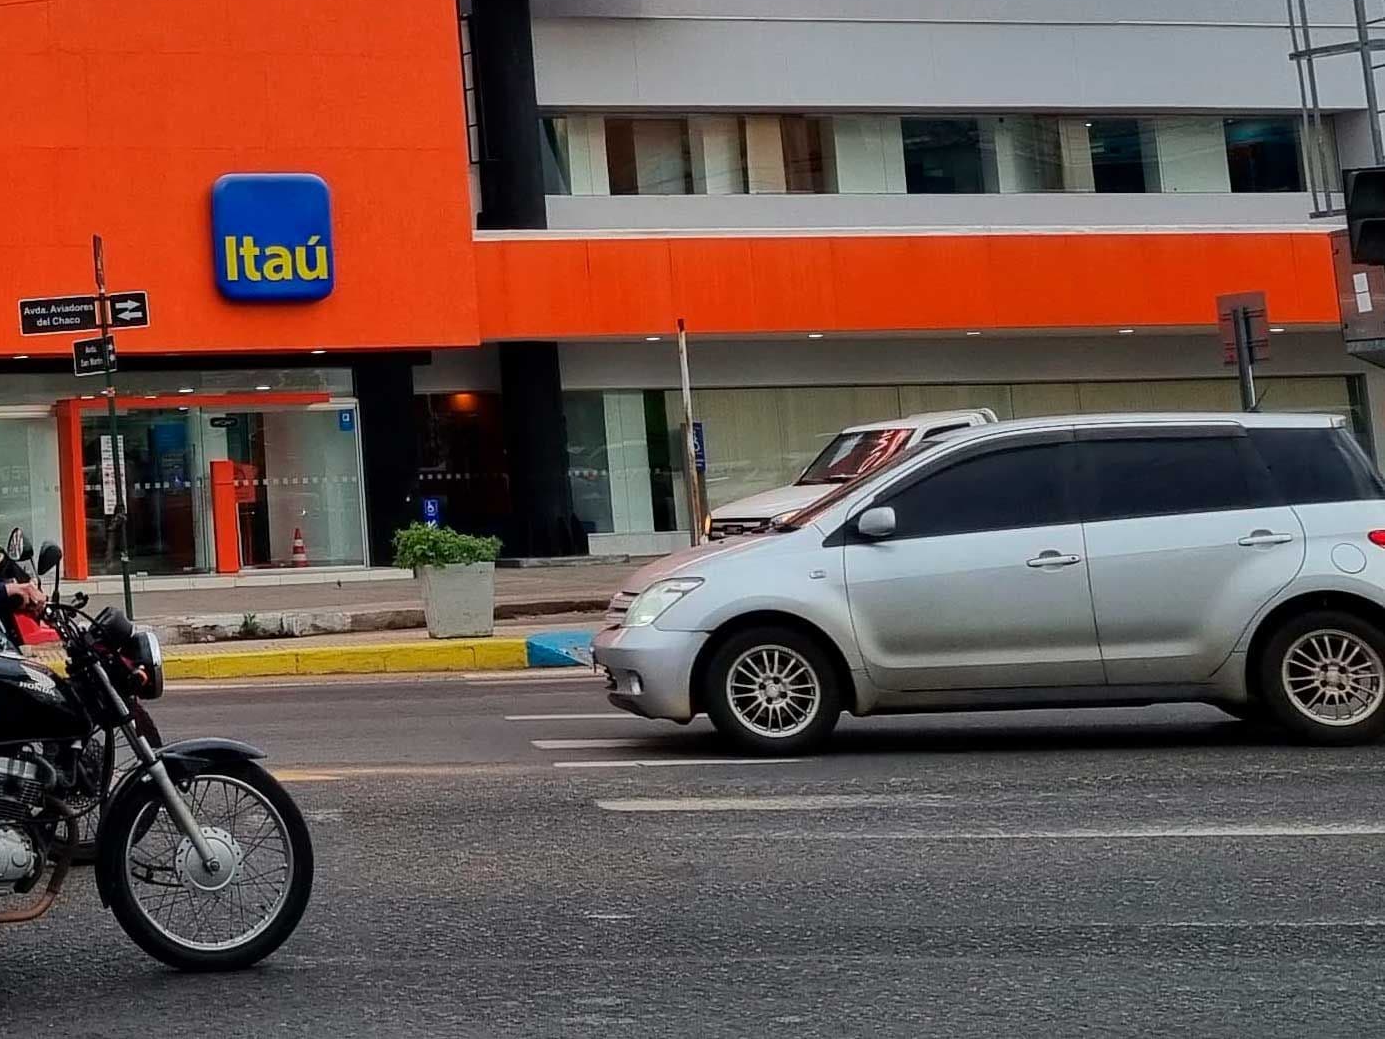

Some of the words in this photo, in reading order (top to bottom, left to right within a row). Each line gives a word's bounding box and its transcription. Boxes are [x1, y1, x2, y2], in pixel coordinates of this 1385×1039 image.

[224, 235, 328, 281] Itaú
[50, 303, 94, 313] Aviadores
[36, 318, 50, 327] del
[52, 316, 81, 325] Chaco
[19, 681, 56, 697] HONDA
